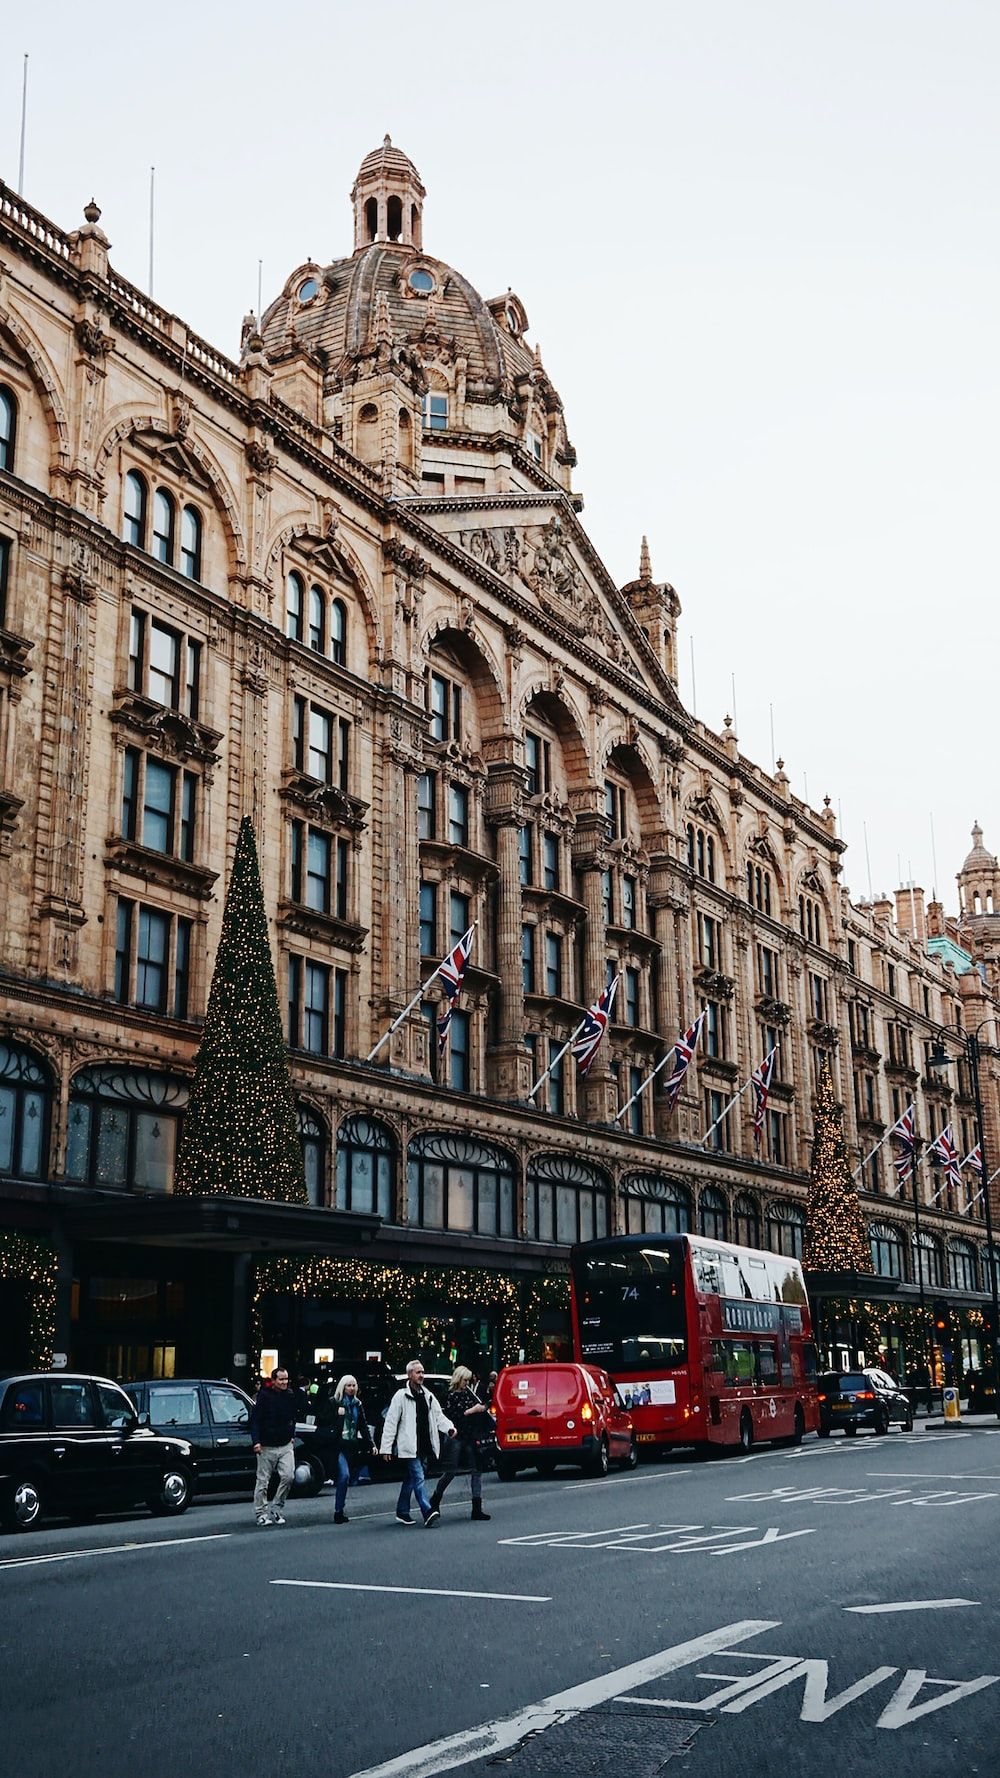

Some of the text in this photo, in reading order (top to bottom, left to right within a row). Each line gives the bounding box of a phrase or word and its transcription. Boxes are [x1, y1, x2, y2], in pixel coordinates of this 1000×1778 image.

[621, 1286, 640, 1301] 74
[724, 1487, 1000, 1506] CLEAR
[498, 1523, 817, 1556] KEEP
